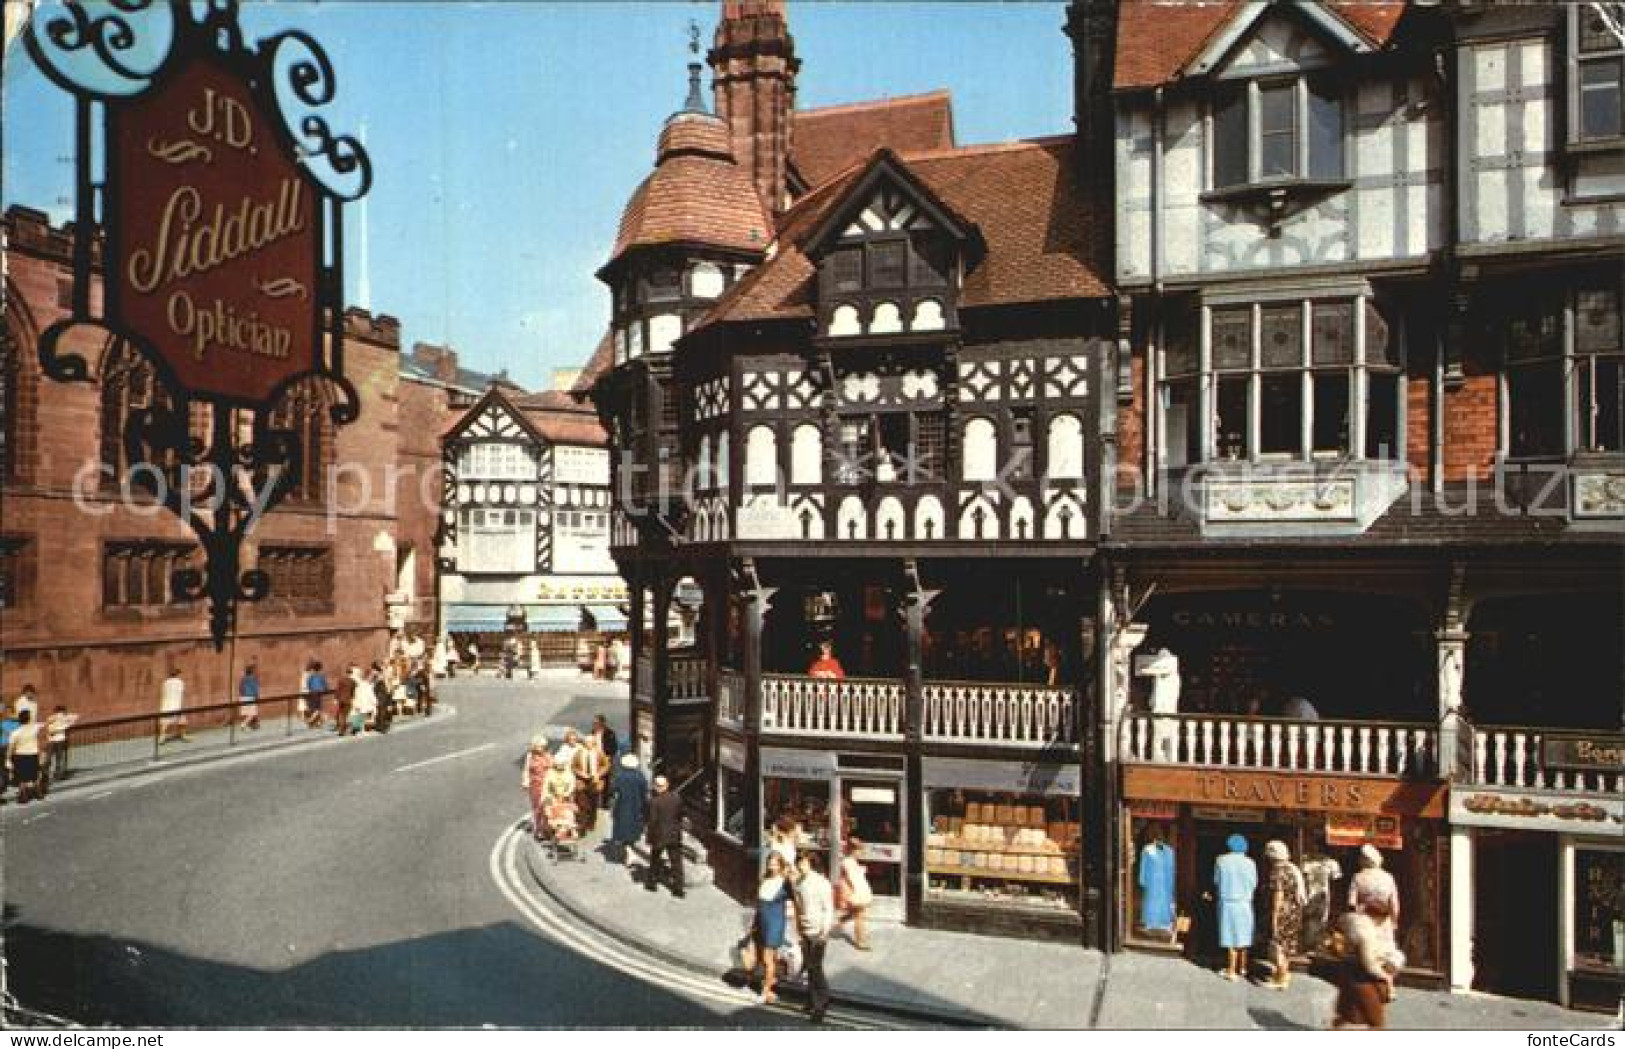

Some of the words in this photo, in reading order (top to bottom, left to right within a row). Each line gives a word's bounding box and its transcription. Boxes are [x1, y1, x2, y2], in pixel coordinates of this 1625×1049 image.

[188, 88, 259, 154] J.D.
[129, 178, 304, 292] Siddall
[167, 292, 293, 361] Optician
[1171, 611, 1335, 628] CAMERAS
[1200, 774, 1366, 804] TRAVERS
